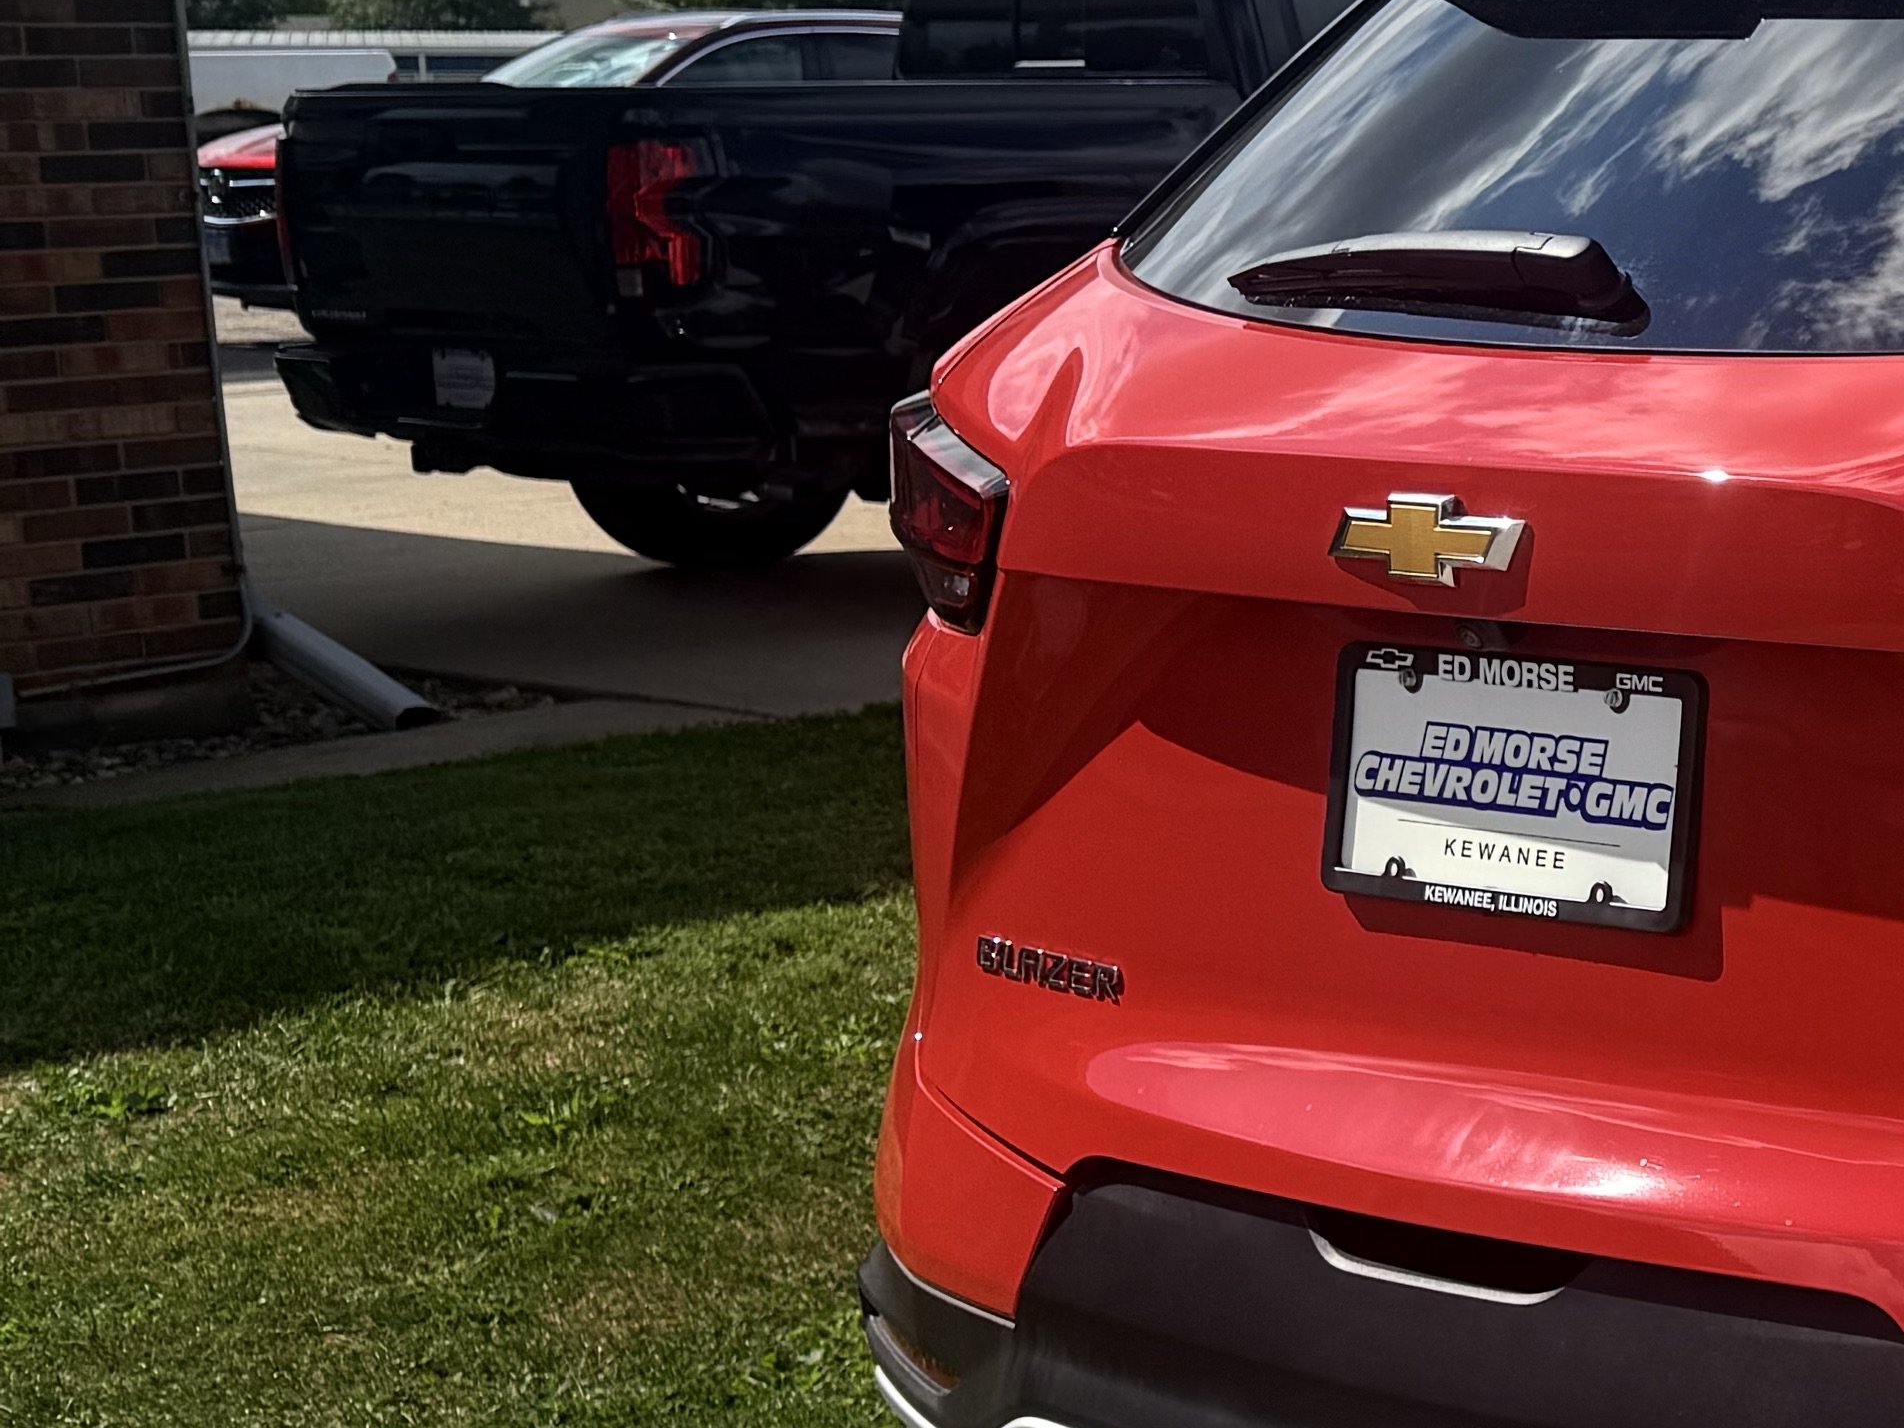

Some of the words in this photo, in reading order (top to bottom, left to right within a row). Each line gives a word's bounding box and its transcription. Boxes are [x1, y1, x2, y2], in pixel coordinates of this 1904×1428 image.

[1437, 653, 1472, 682] ED
[1479, 657, 1575, 693] MORSE
[1615, 672, 1664, 693] GMC
[1420, 723, 1471, 761] ED
[1471, 728, 1607, 776] MORSE
[1444, 838, 1566, 870] KEWANEE
[1424, 884, 1496, 912] KEWANEE,
[1498, 894, 1558, 918] ILLINOIS
[976, 934, 1123, 1007] BLAZER
